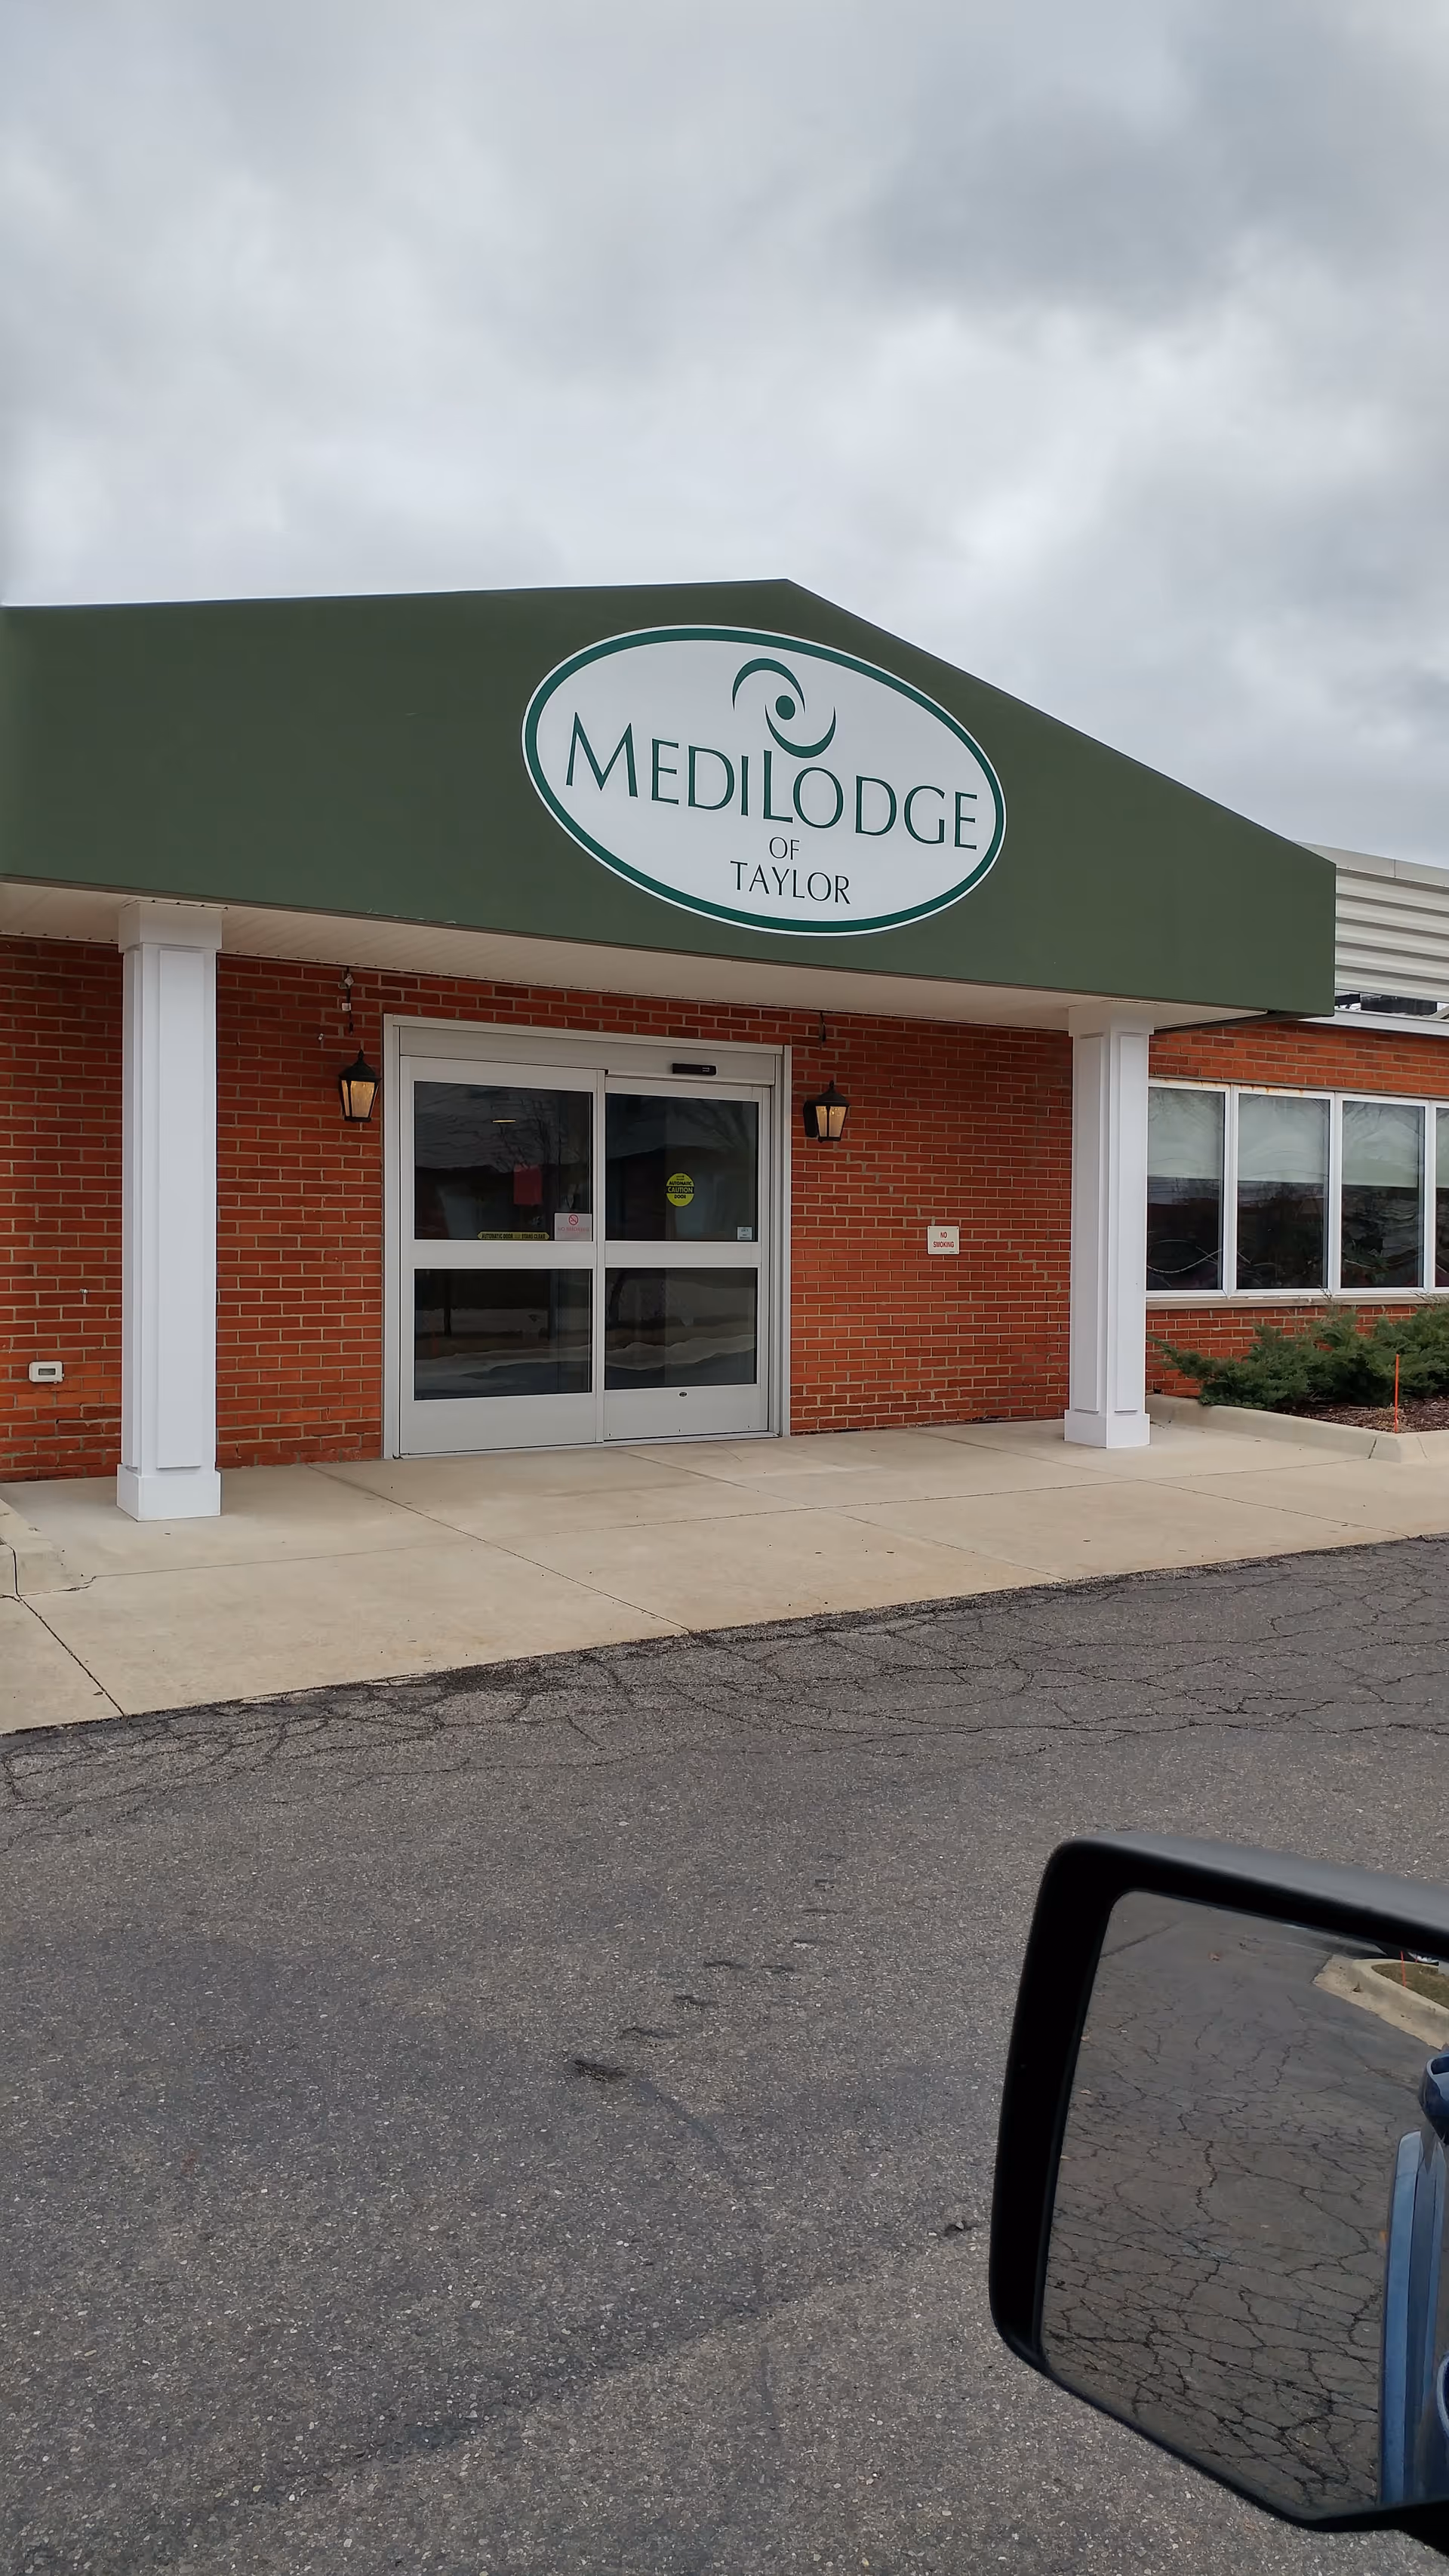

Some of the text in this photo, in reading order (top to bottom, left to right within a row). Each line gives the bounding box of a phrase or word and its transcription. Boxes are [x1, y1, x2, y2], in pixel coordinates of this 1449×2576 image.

[566, 712, 977, 850] MEDILODGE
[769, 836, 800, 860] OF
[731, 860, 851, 904] TAYLOR
